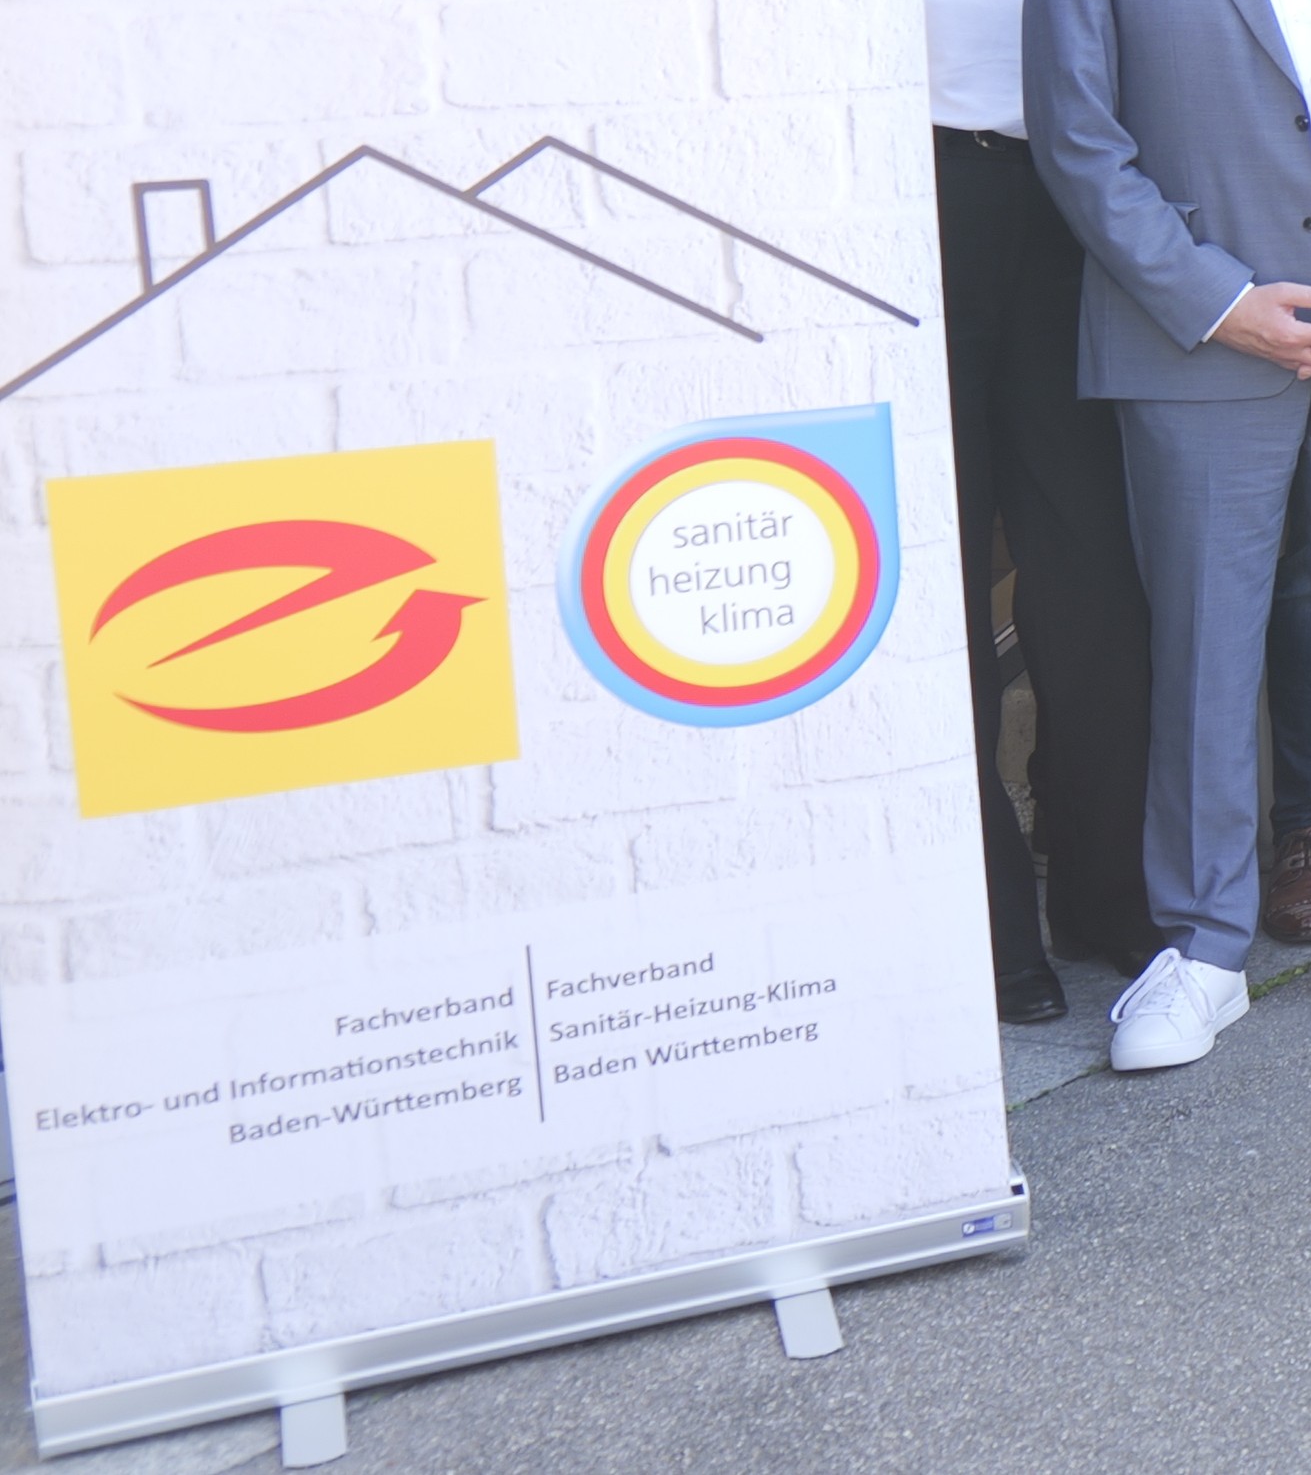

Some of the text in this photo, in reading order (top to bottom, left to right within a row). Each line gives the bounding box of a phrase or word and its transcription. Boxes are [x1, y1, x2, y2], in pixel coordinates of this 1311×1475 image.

[673, 511, 793, 549] sanitär
[649, 561, 792, 597] heizung
[700, 602, 795, 635] klima
[547, 952, 715, 1000] Fachverband
[335, 987, 514, 1036] Fachverband
[549, 978, 837, 1042] Sanitär-Heizung-Klima
[554, 1022, 819, 1084] Baden Württemberg
[35, 1031, 519, 1131] Elektro- und Informationstechnik
[228, 1074, 523, 1144] Baden-Württemberg
